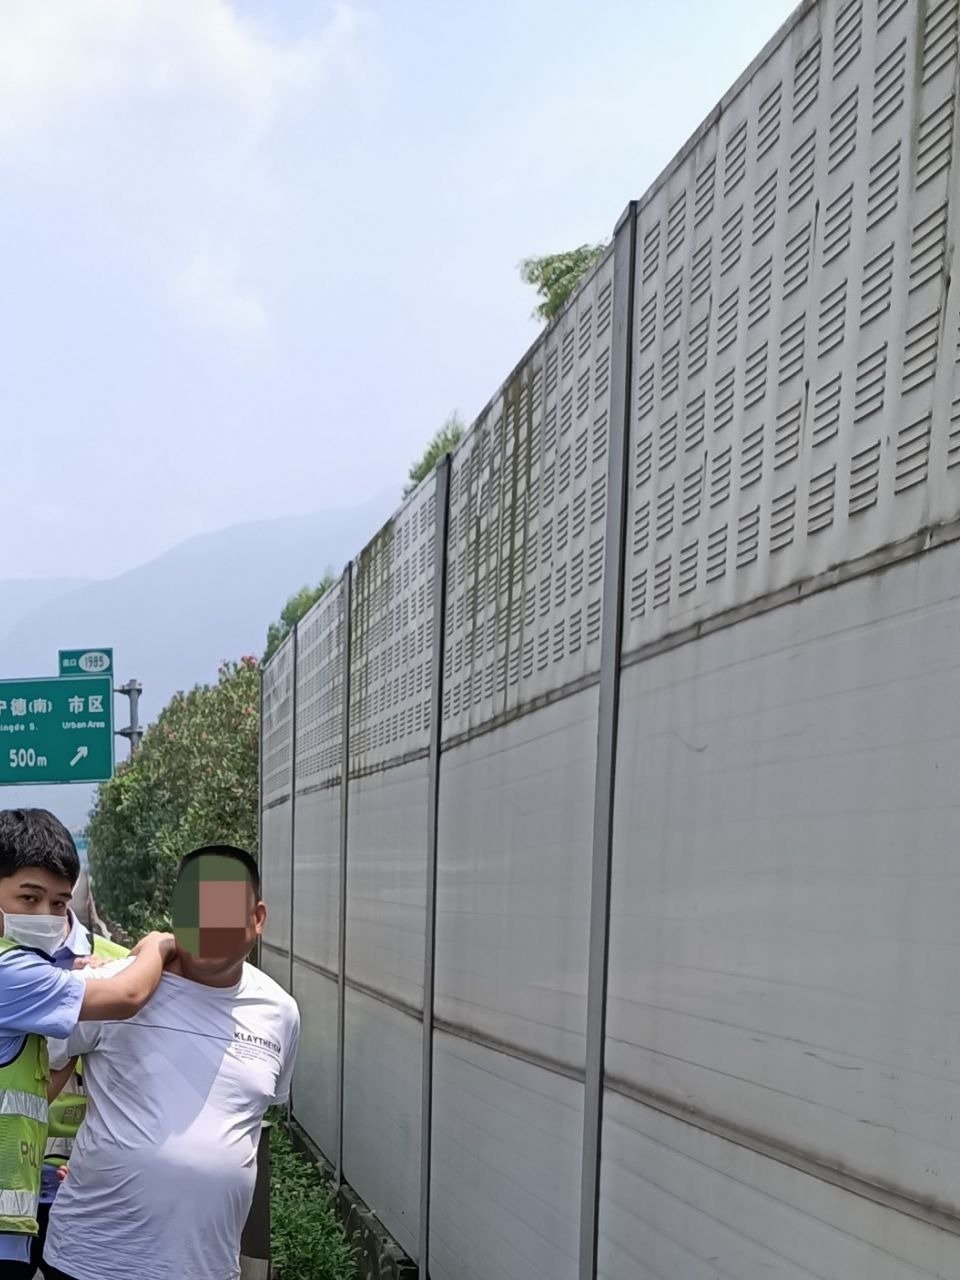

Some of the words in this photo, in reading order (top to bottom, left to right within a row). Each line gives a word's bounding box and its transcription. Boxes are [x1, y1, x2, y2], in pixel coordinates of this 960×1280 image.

[84, 655, 104, 669] 1985
[68, 695, 104, 714] 市区
[62, 721, 87, 730] Urban
[87, 720, 105, 729] Area
[9, 748, 47, 767] 500m
